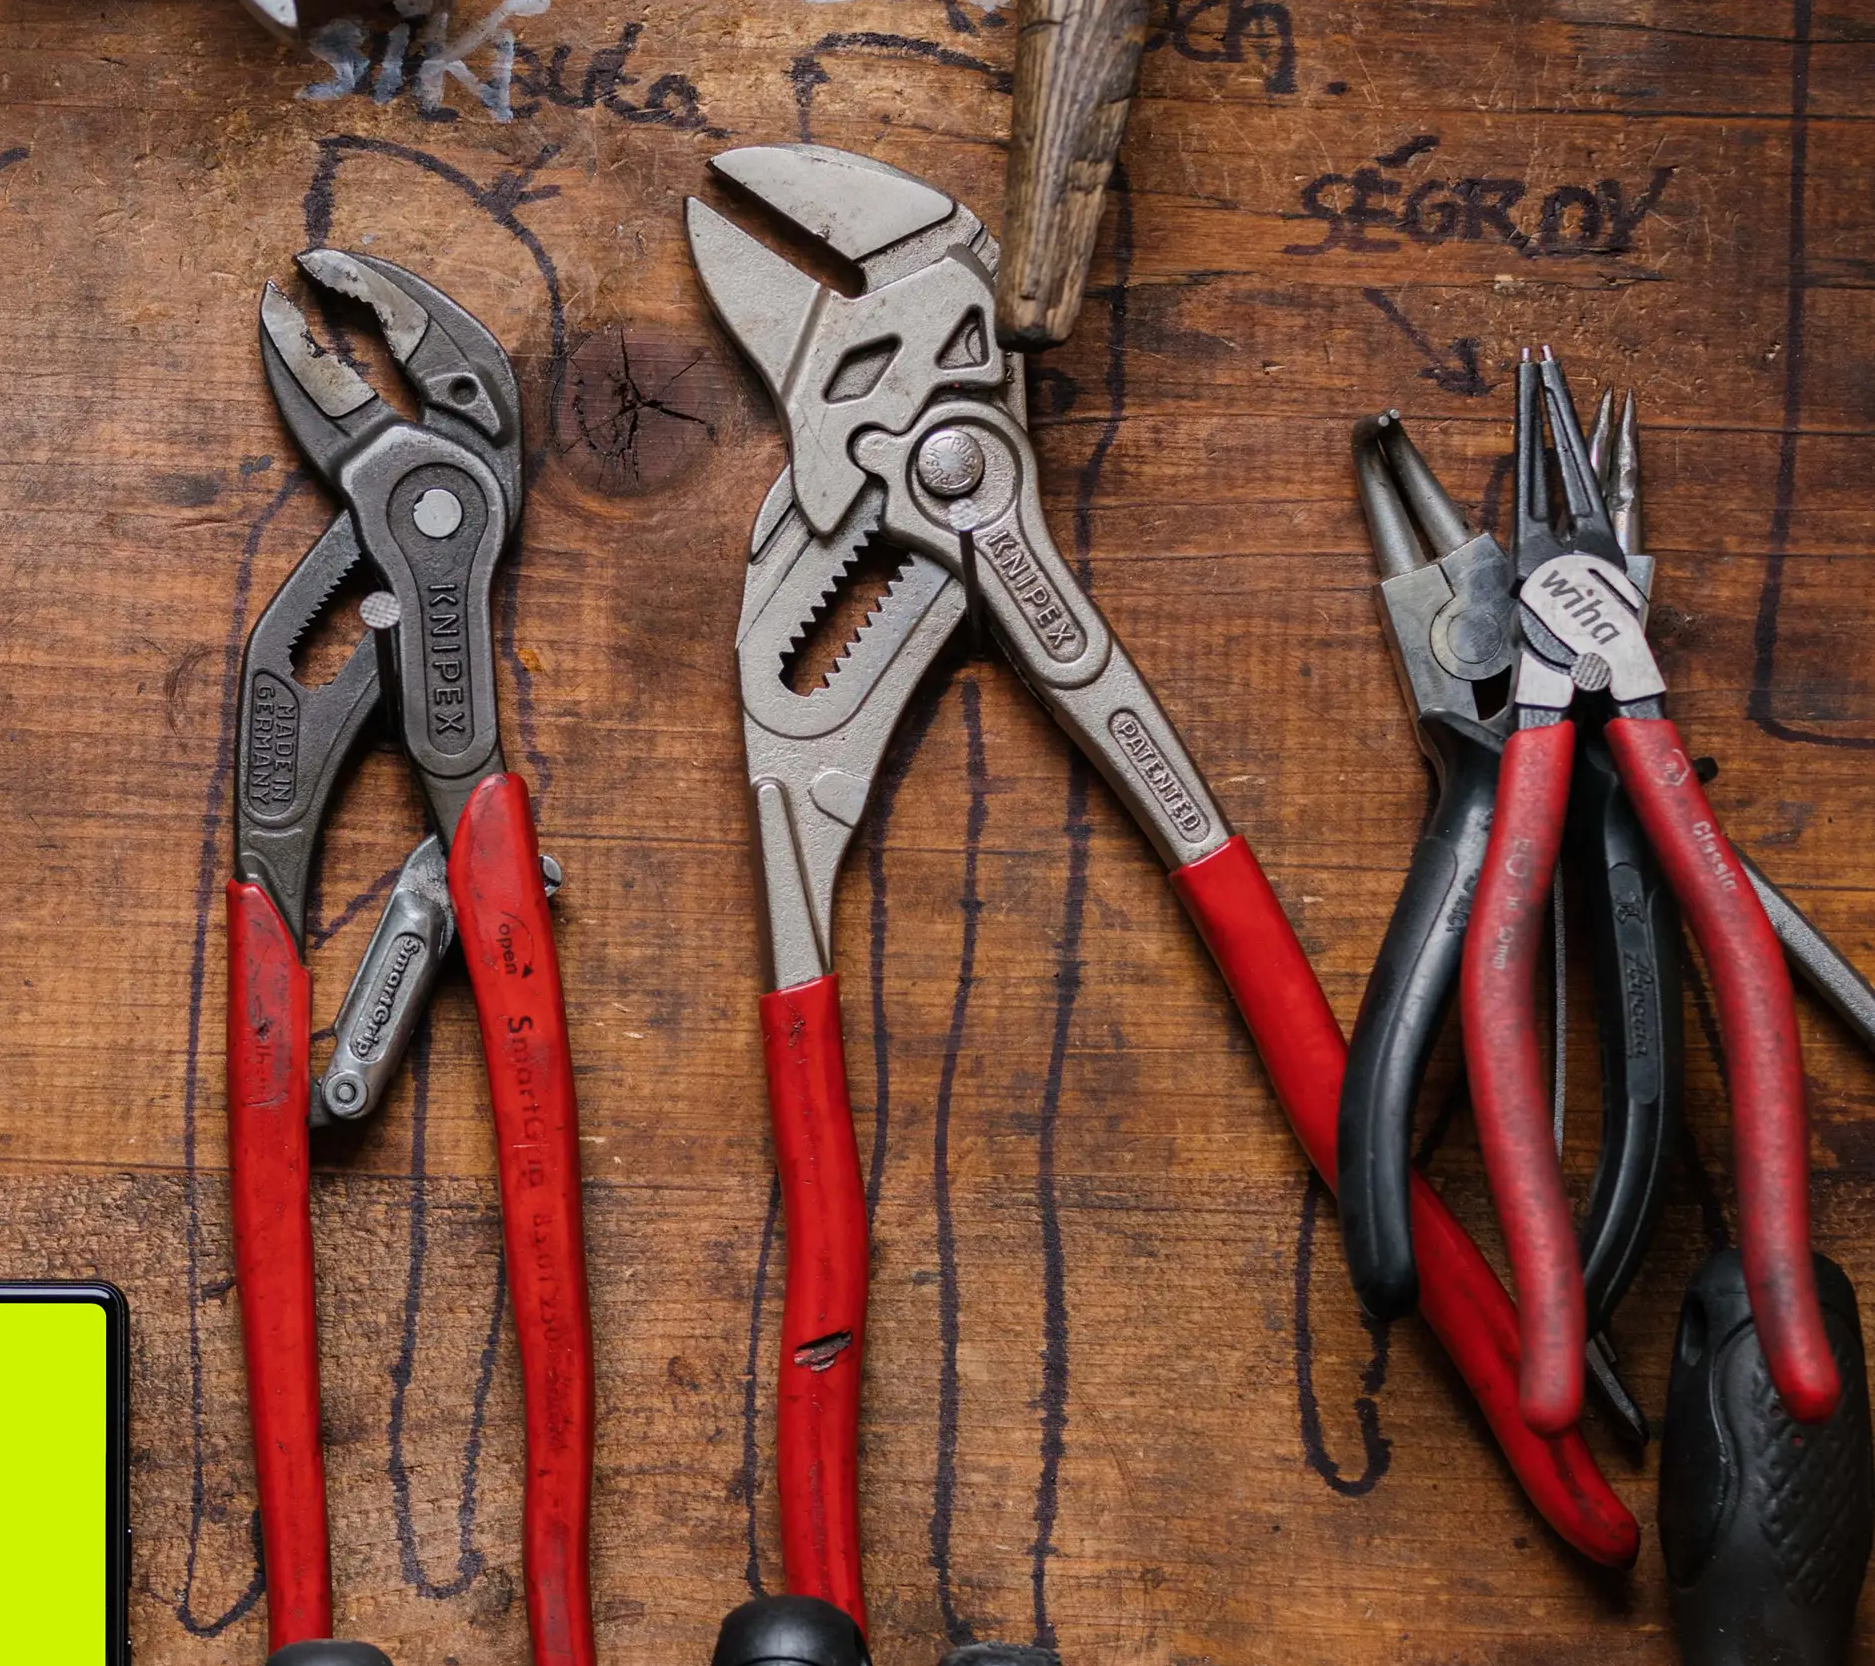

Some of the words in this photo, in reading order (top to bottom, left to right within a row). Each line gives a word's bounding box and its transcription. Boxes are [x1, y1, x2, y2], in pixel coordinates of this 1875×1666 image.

[986, 528, 1080, 651] KNIPEX
[1539, 569, 1621, 646] wiha
[428, 583, 468, 735] KNIPEX
[250, 684, 276, 805] GERMANY
[272, 778, 293, 803] IN
[275, 704, 296, 772] MADE
[1115, 720, 1203, 836] PATENTED
[353, 935, 421, 1059] SmartGrip
[495, 922, 519, 976] open
